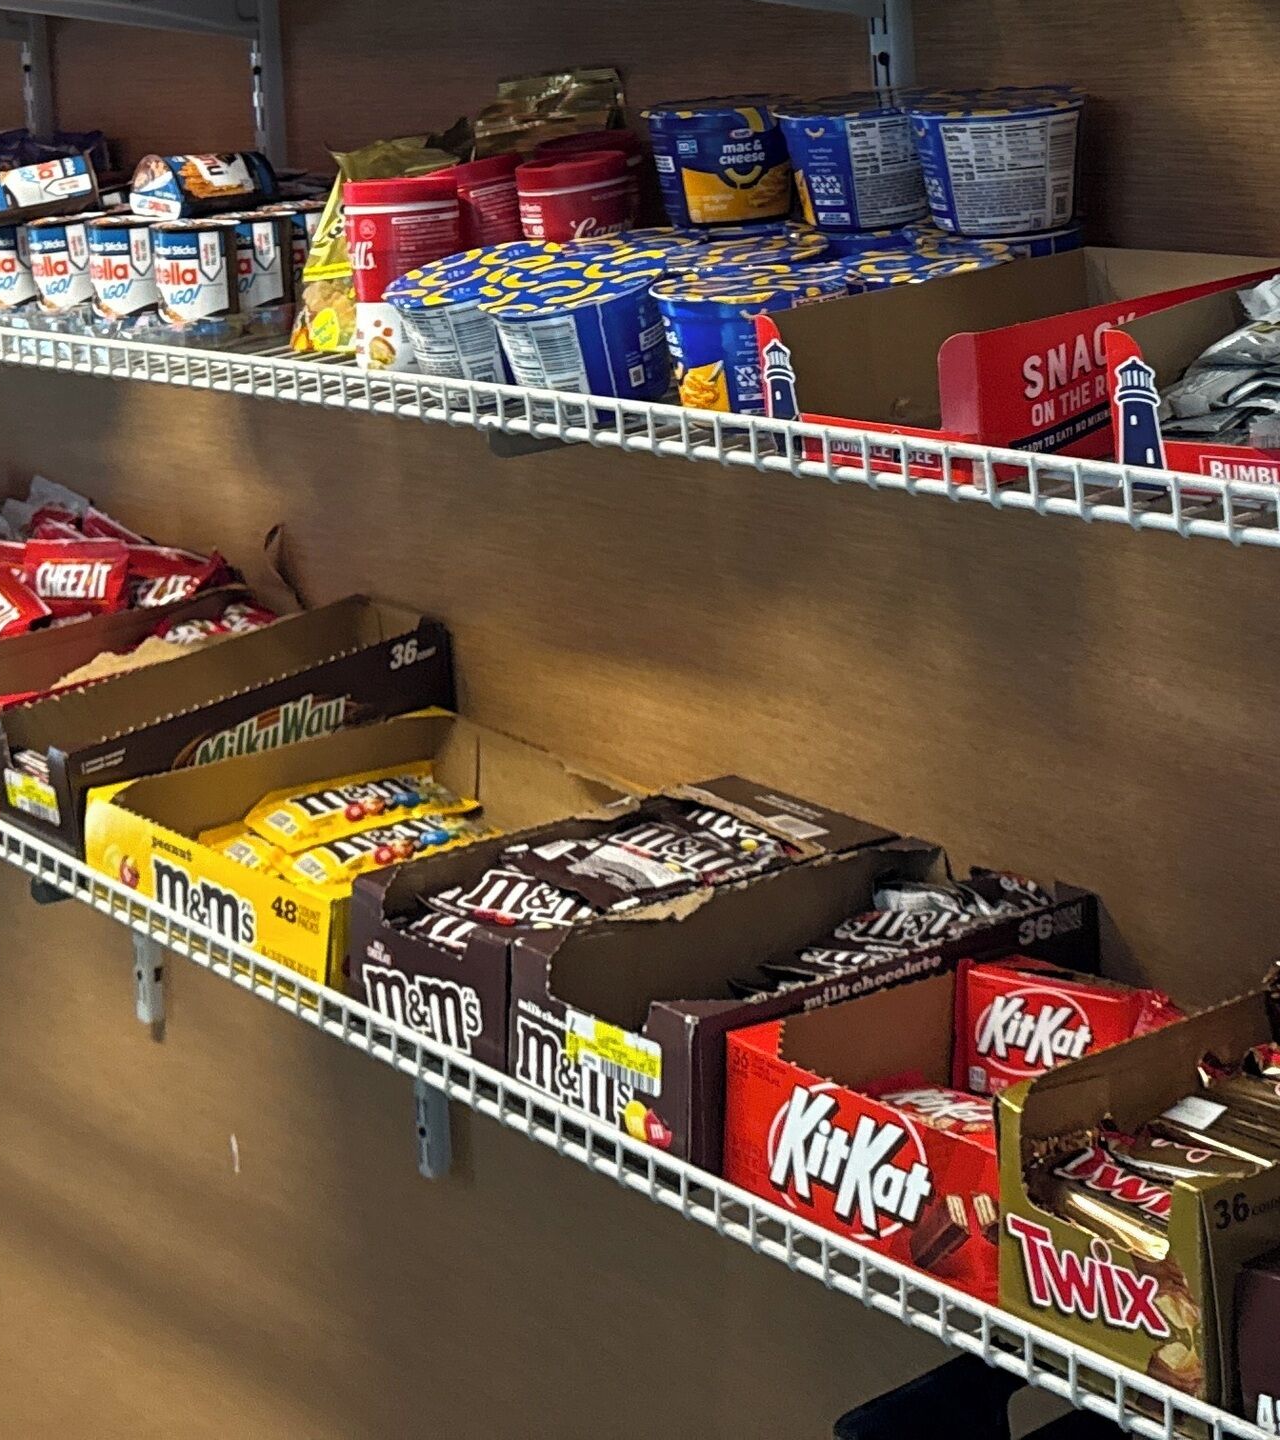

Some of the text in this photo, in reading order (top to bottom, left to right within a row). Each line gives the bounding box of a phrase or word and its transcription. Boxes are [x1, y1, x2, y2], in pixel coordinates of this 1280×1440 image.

[722, 139, 763, 153] mac &
[1031, 387, 1093, 428] ON THE
[390, 638, 419, 670] 36
[152, 835, 193, 862] peanut
[271, 895, 298, 924] 48
[1018, 913, 1054, 946] 36
[803, 955, 943, 1012] milk chocolate
[1212, 1190, 1250, 1231] 36
